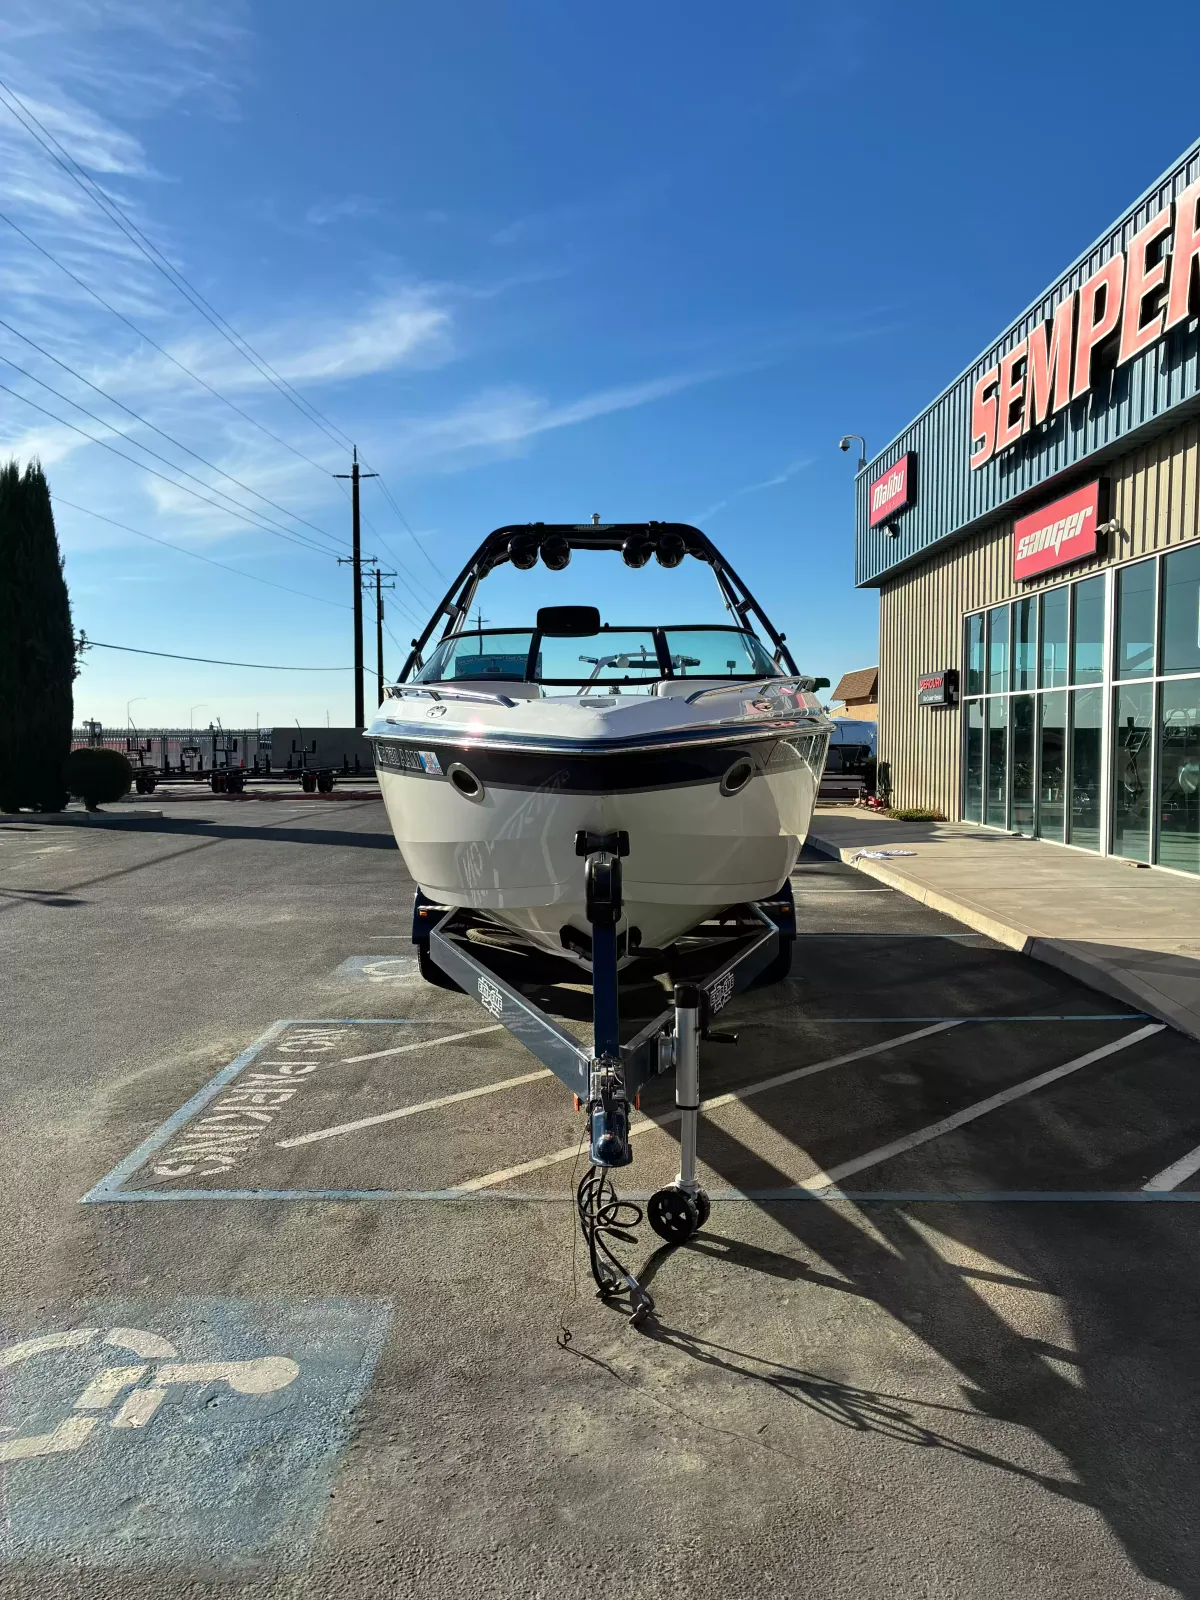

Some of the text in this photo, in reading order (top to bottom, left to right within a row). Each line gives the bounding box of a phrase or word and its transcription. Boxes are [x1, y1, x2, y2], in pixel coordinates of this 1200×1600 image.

[872, 470, 905, 513] Malibu
[919, 677, 944, 690] MERCURY
[153, 1028, 348, 1177] NO PARKING
